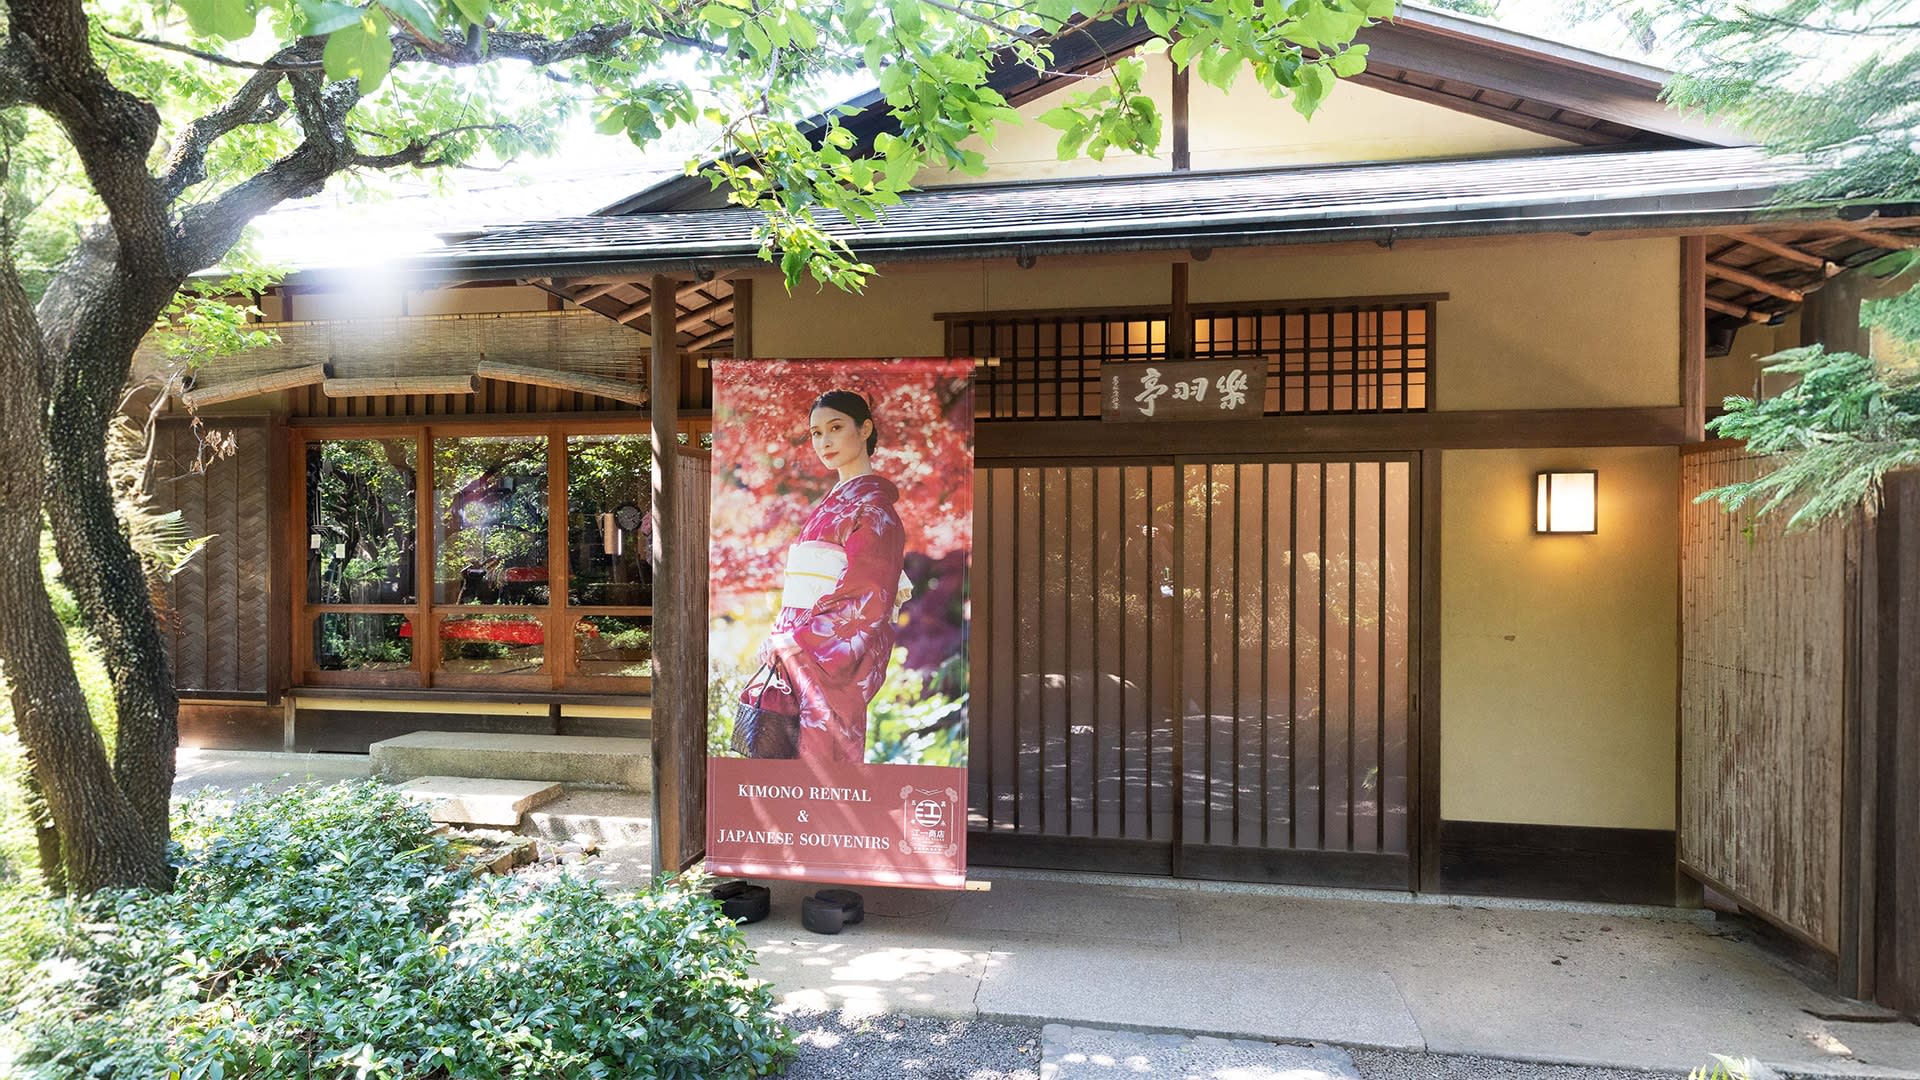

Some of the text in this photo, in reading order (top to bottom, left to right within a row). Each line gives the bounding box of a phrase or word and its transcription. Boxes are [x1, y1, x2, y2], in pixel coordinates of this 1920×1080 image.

[738, 784, 871, 802] KIMONO RENTAL
[797, 810, 809, 823] &
[717, 829, 794, 845] JAPANESE
[799, 834, 890, 850] SOUVENIRS
